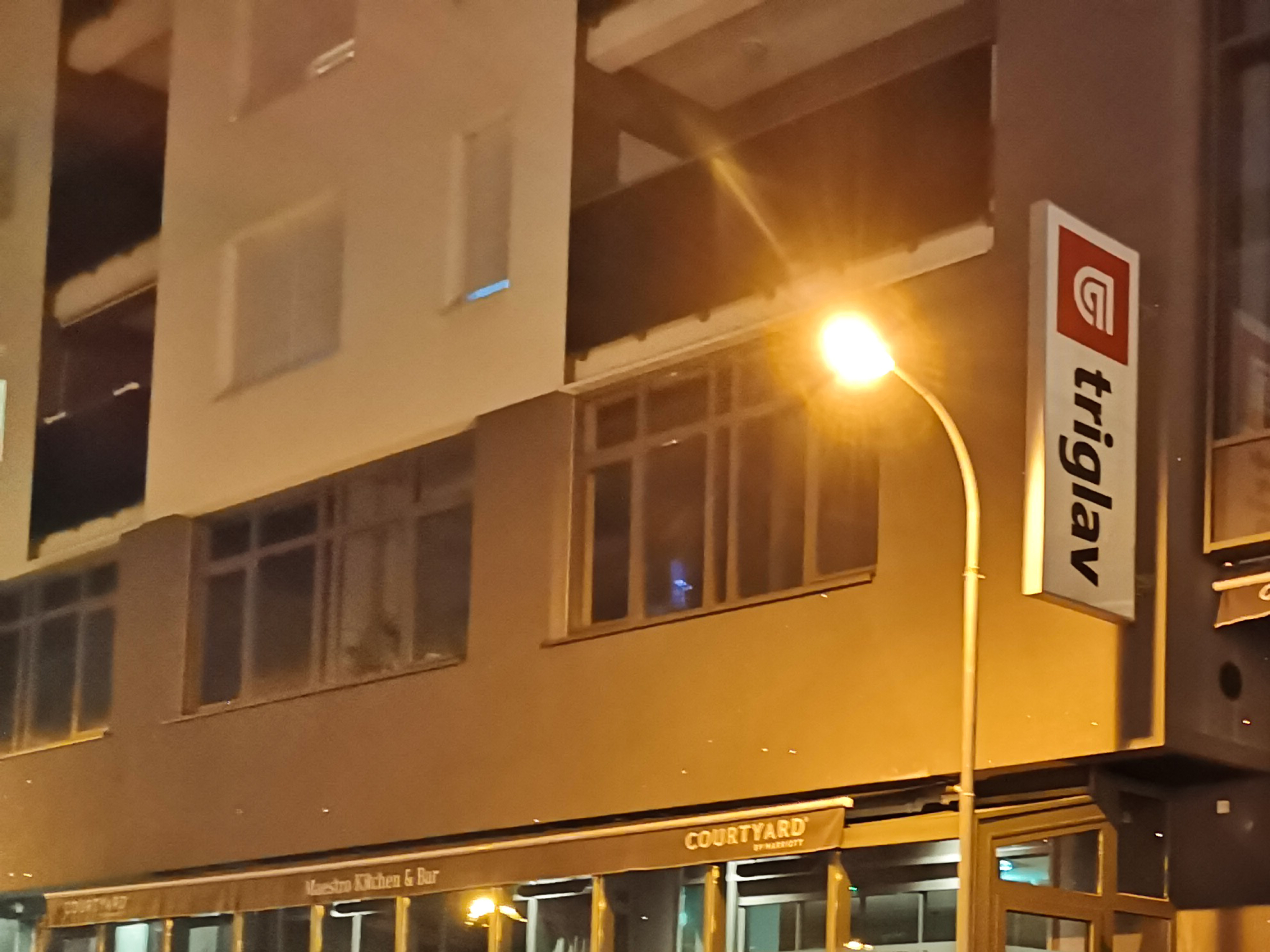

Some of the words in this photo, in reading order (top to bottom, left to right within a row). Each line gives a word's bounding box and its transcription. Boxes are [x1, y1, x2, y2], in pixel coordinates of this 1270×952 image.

[1059, 366, 1114, 587] triglav
[685, 817, 807, 850] COURTYARD
[354, 872, 401, 892] Kitchen
[404, 868, 414, 887] &
[417, 866, 440, 886] Bar
